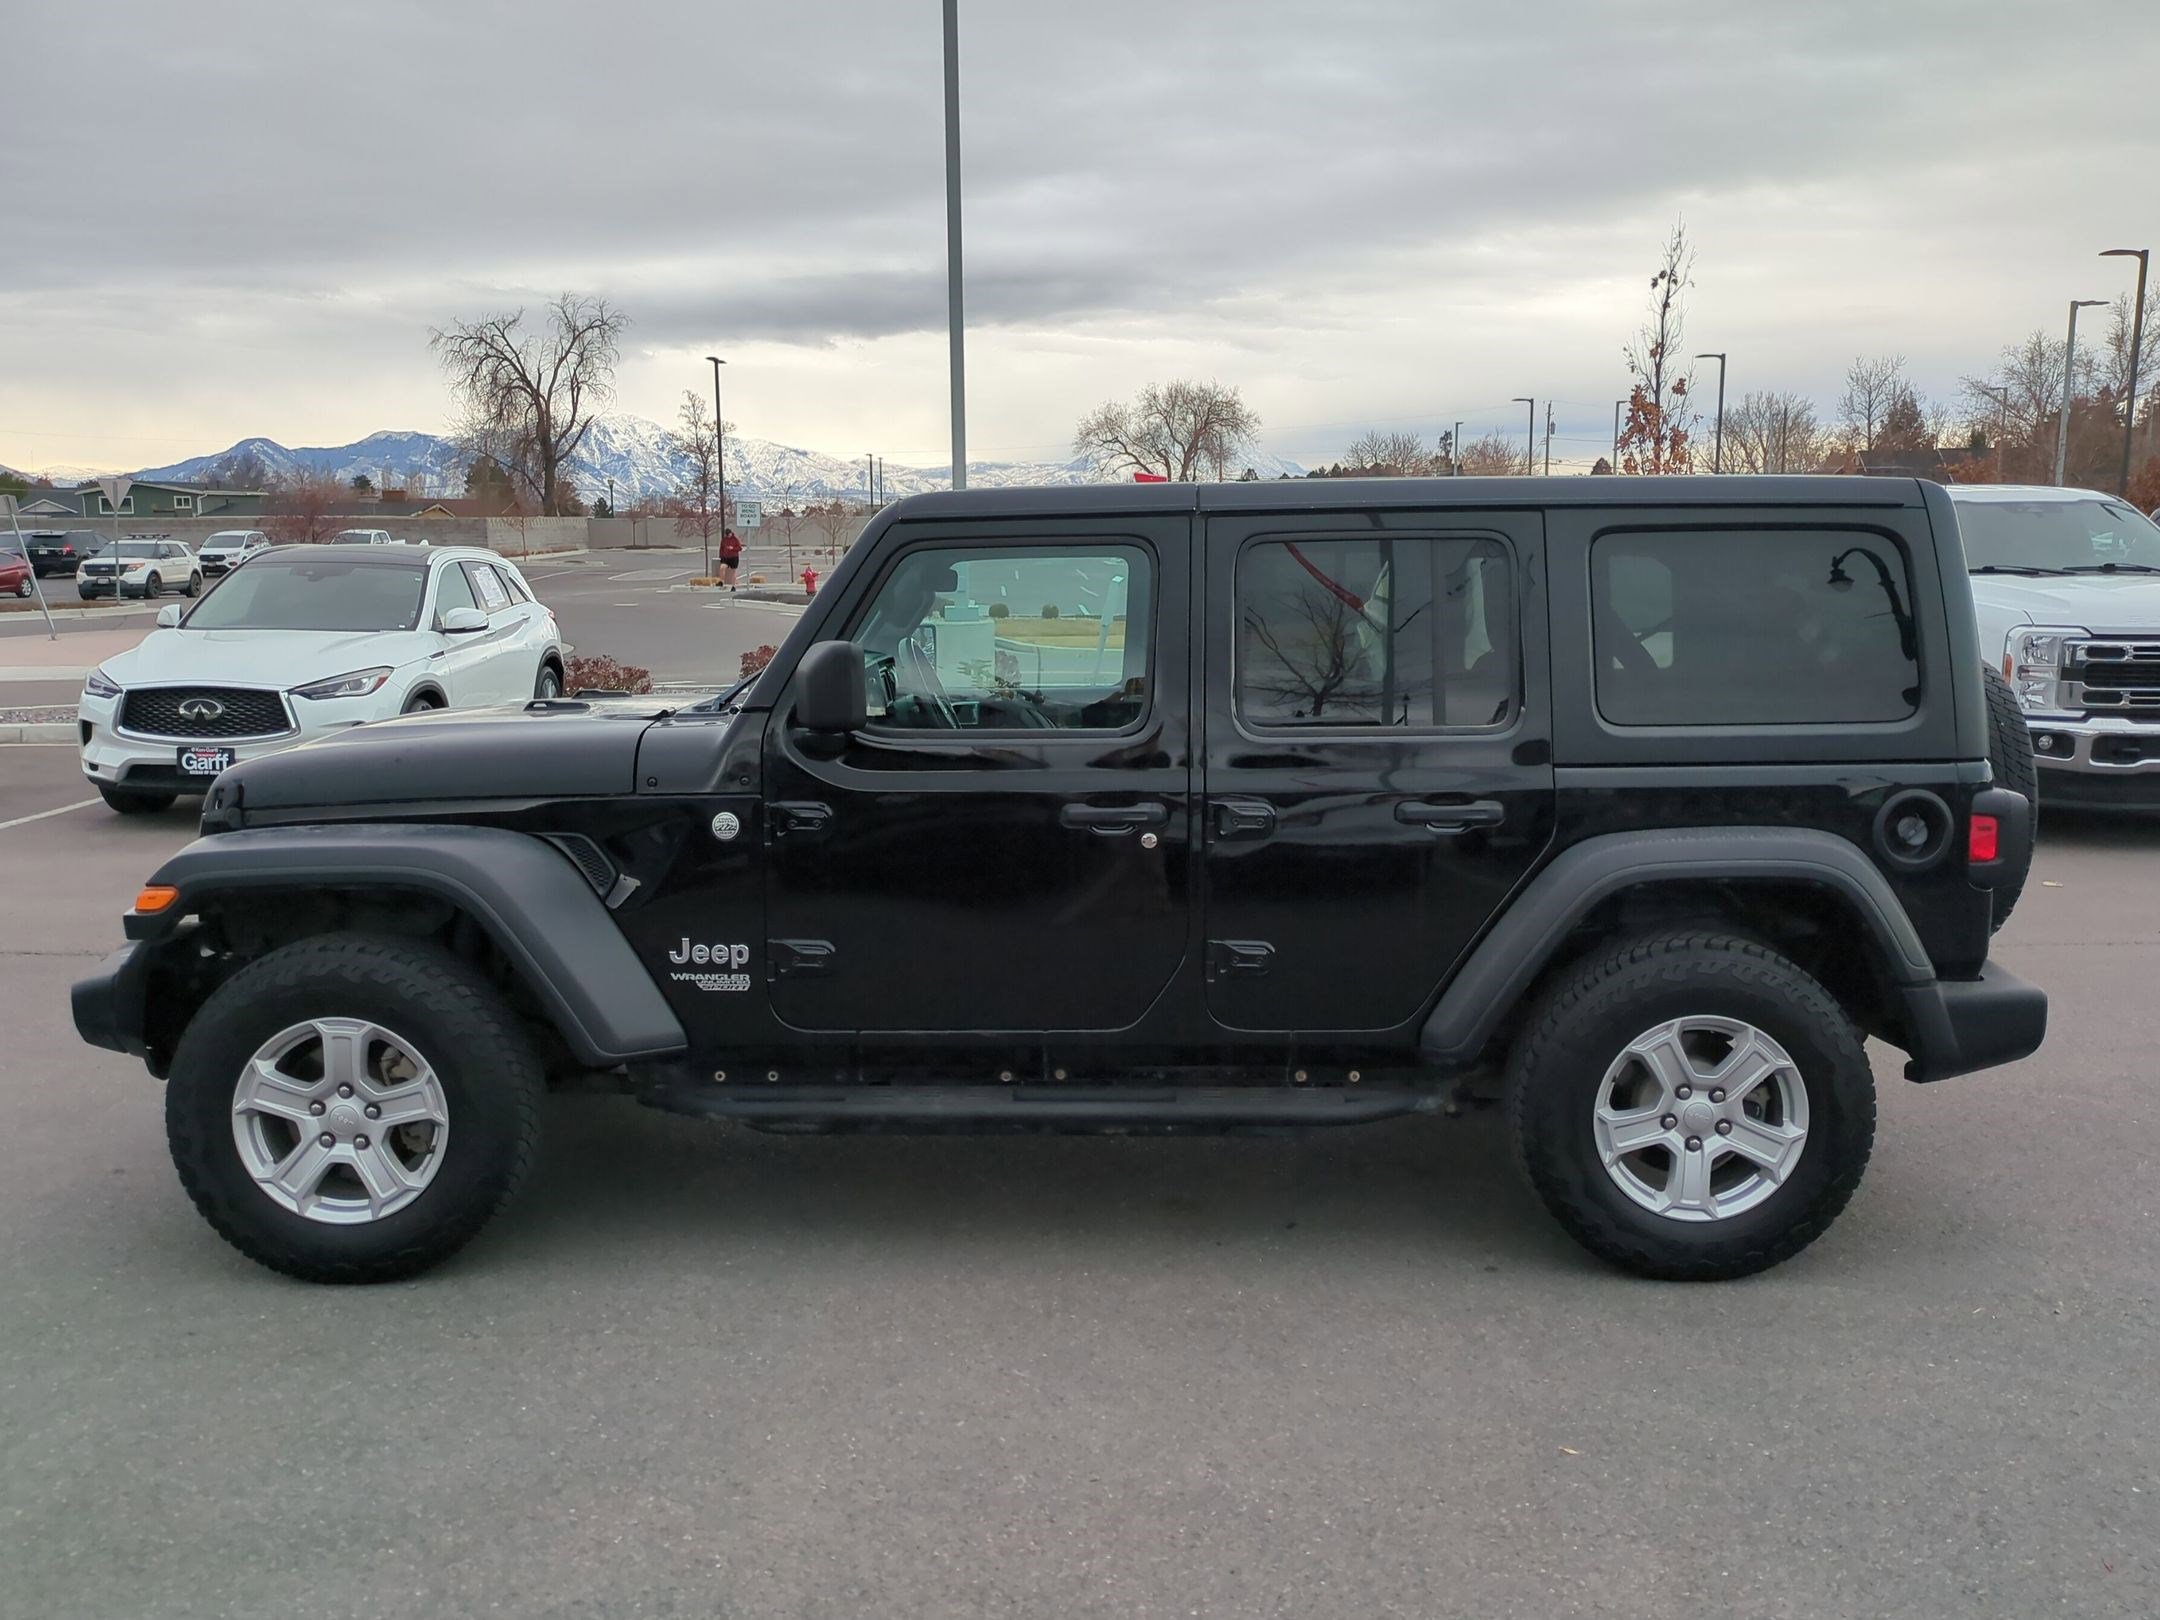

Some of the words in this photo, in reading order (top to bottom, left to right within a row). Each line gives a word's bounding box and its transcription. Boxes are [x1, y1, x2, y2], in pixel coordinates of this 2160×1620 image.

[181, 753, 229, 770] Garff
[669, 938, 750, 969] Jeep
[670, 972, 750, 981] WRANGLER
